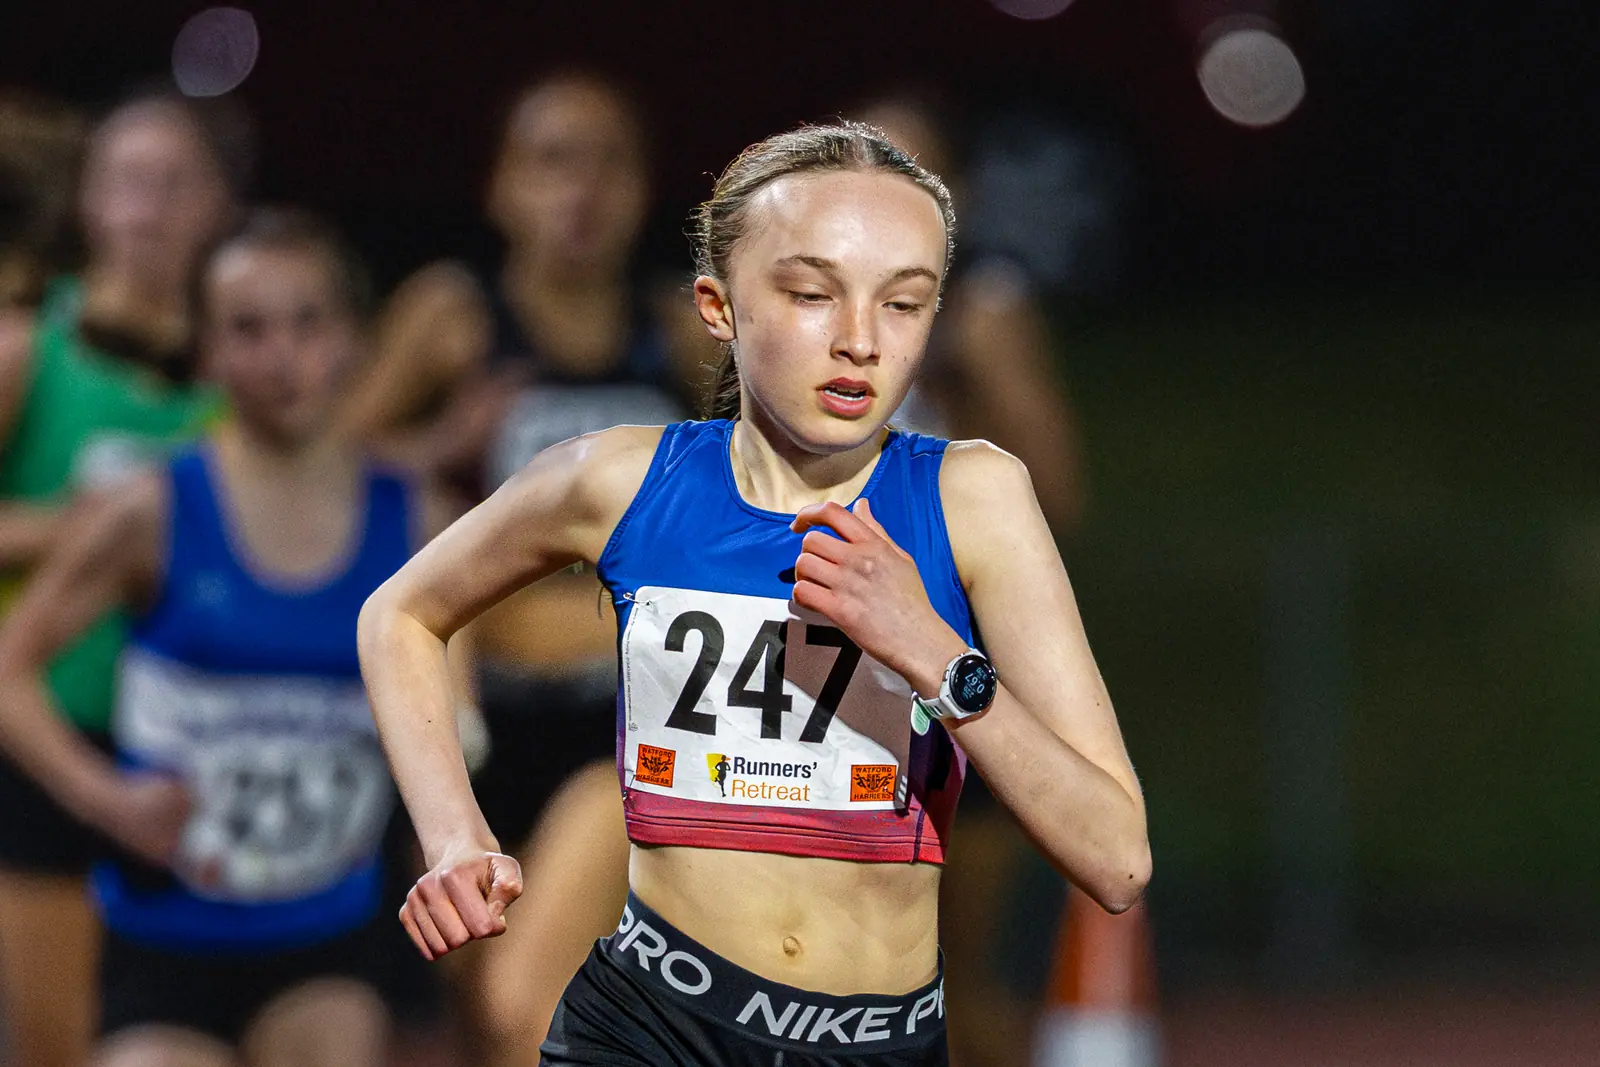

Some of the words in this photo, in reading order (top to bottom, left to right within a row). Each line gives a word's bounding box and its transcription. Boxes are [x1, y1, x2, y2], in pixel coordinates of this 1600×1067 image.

[663, 610, 863, 744] 247
[733, 756, 818, 779] Runners'
[731, 779, 811, 802] Retreat
[735, 990, 903, 1044] NIKE
